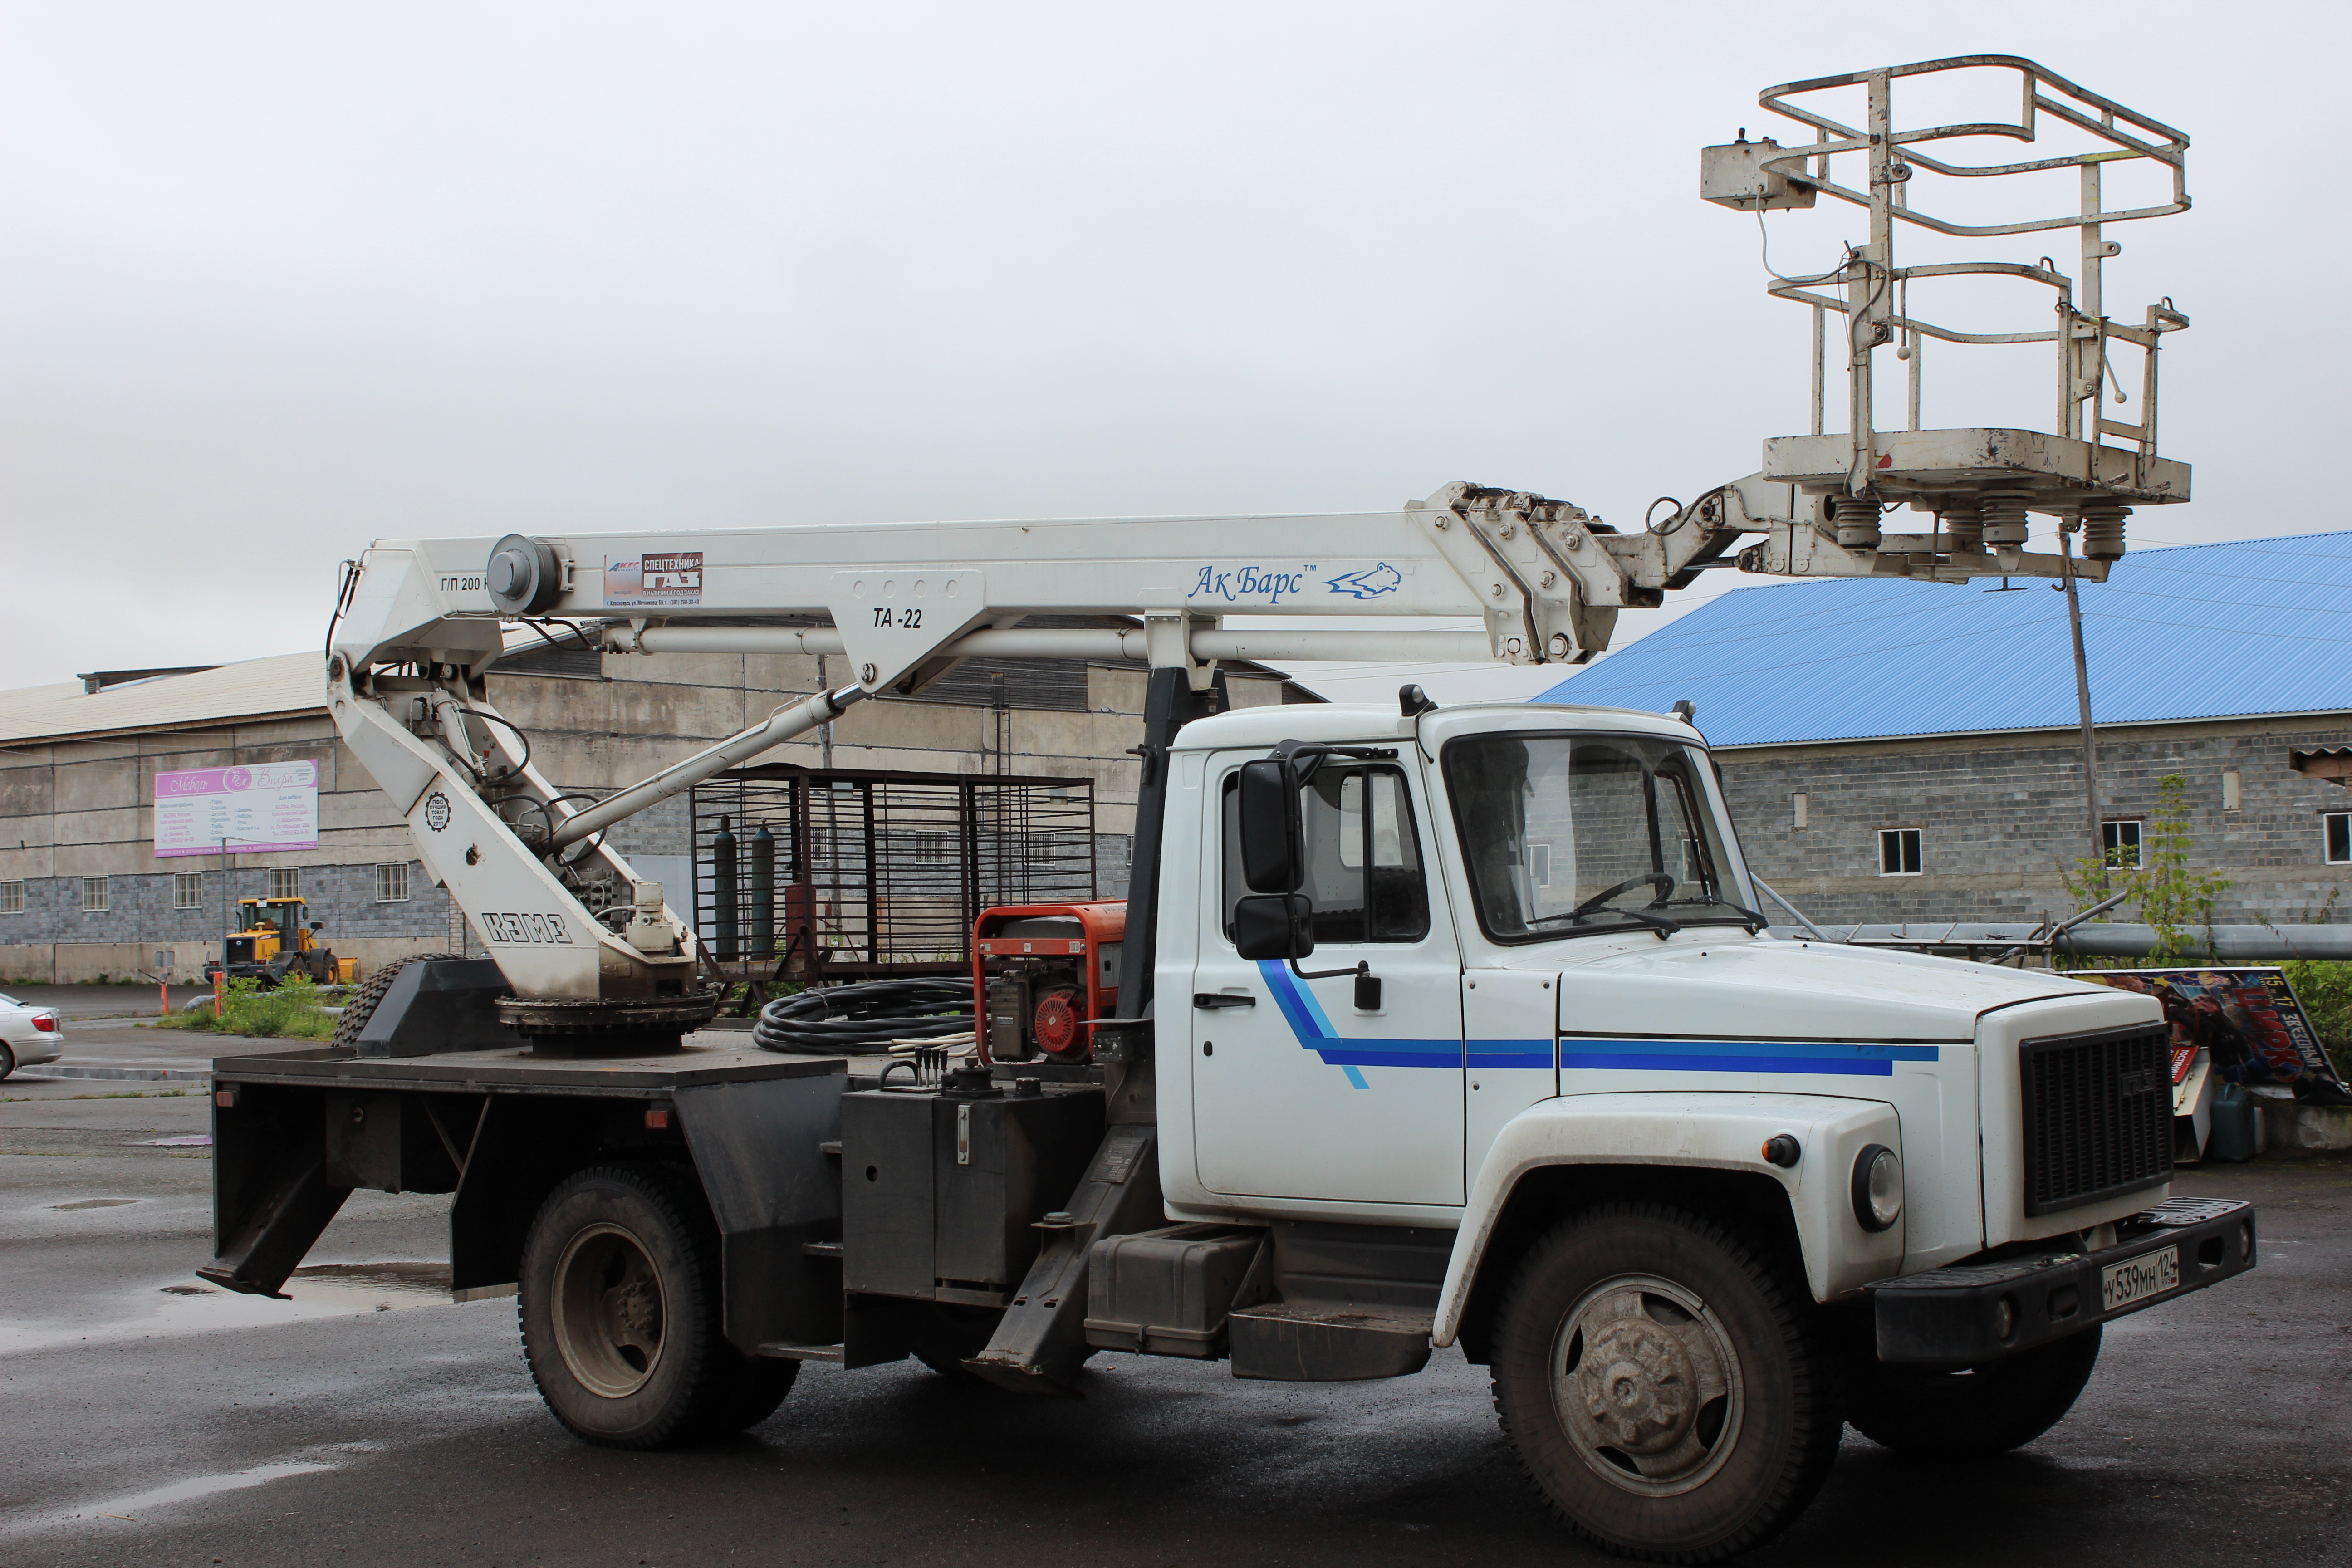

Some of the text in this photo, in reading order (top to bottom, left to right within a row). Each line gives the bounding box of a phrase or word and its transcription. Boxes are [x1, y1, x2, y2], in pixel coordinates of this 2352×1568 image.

[645, 558, 700, 572] СПЕЦТЕХНИКА
[441, 578, 458, 591] Г/П
[461, 578, 480, 590] 200
[643, 572, 700, 588] ГАЗ
[1188, 565, 1236, 601] Ак
[1237, 566, 1302, 604] Барс
[170, 776, 208, 795] Мебель
[481, 913, 573, 944] КЭМЗ
[2264, 975, 2285, 987] 15
[2277, 996, 2296, 1007] 17
[2232, 987, 2305, 1068] ЦИРК
[2107, 1251, 2177, 1303] У539МН 124
[2161, 1276, 2171, 1286] RUS
